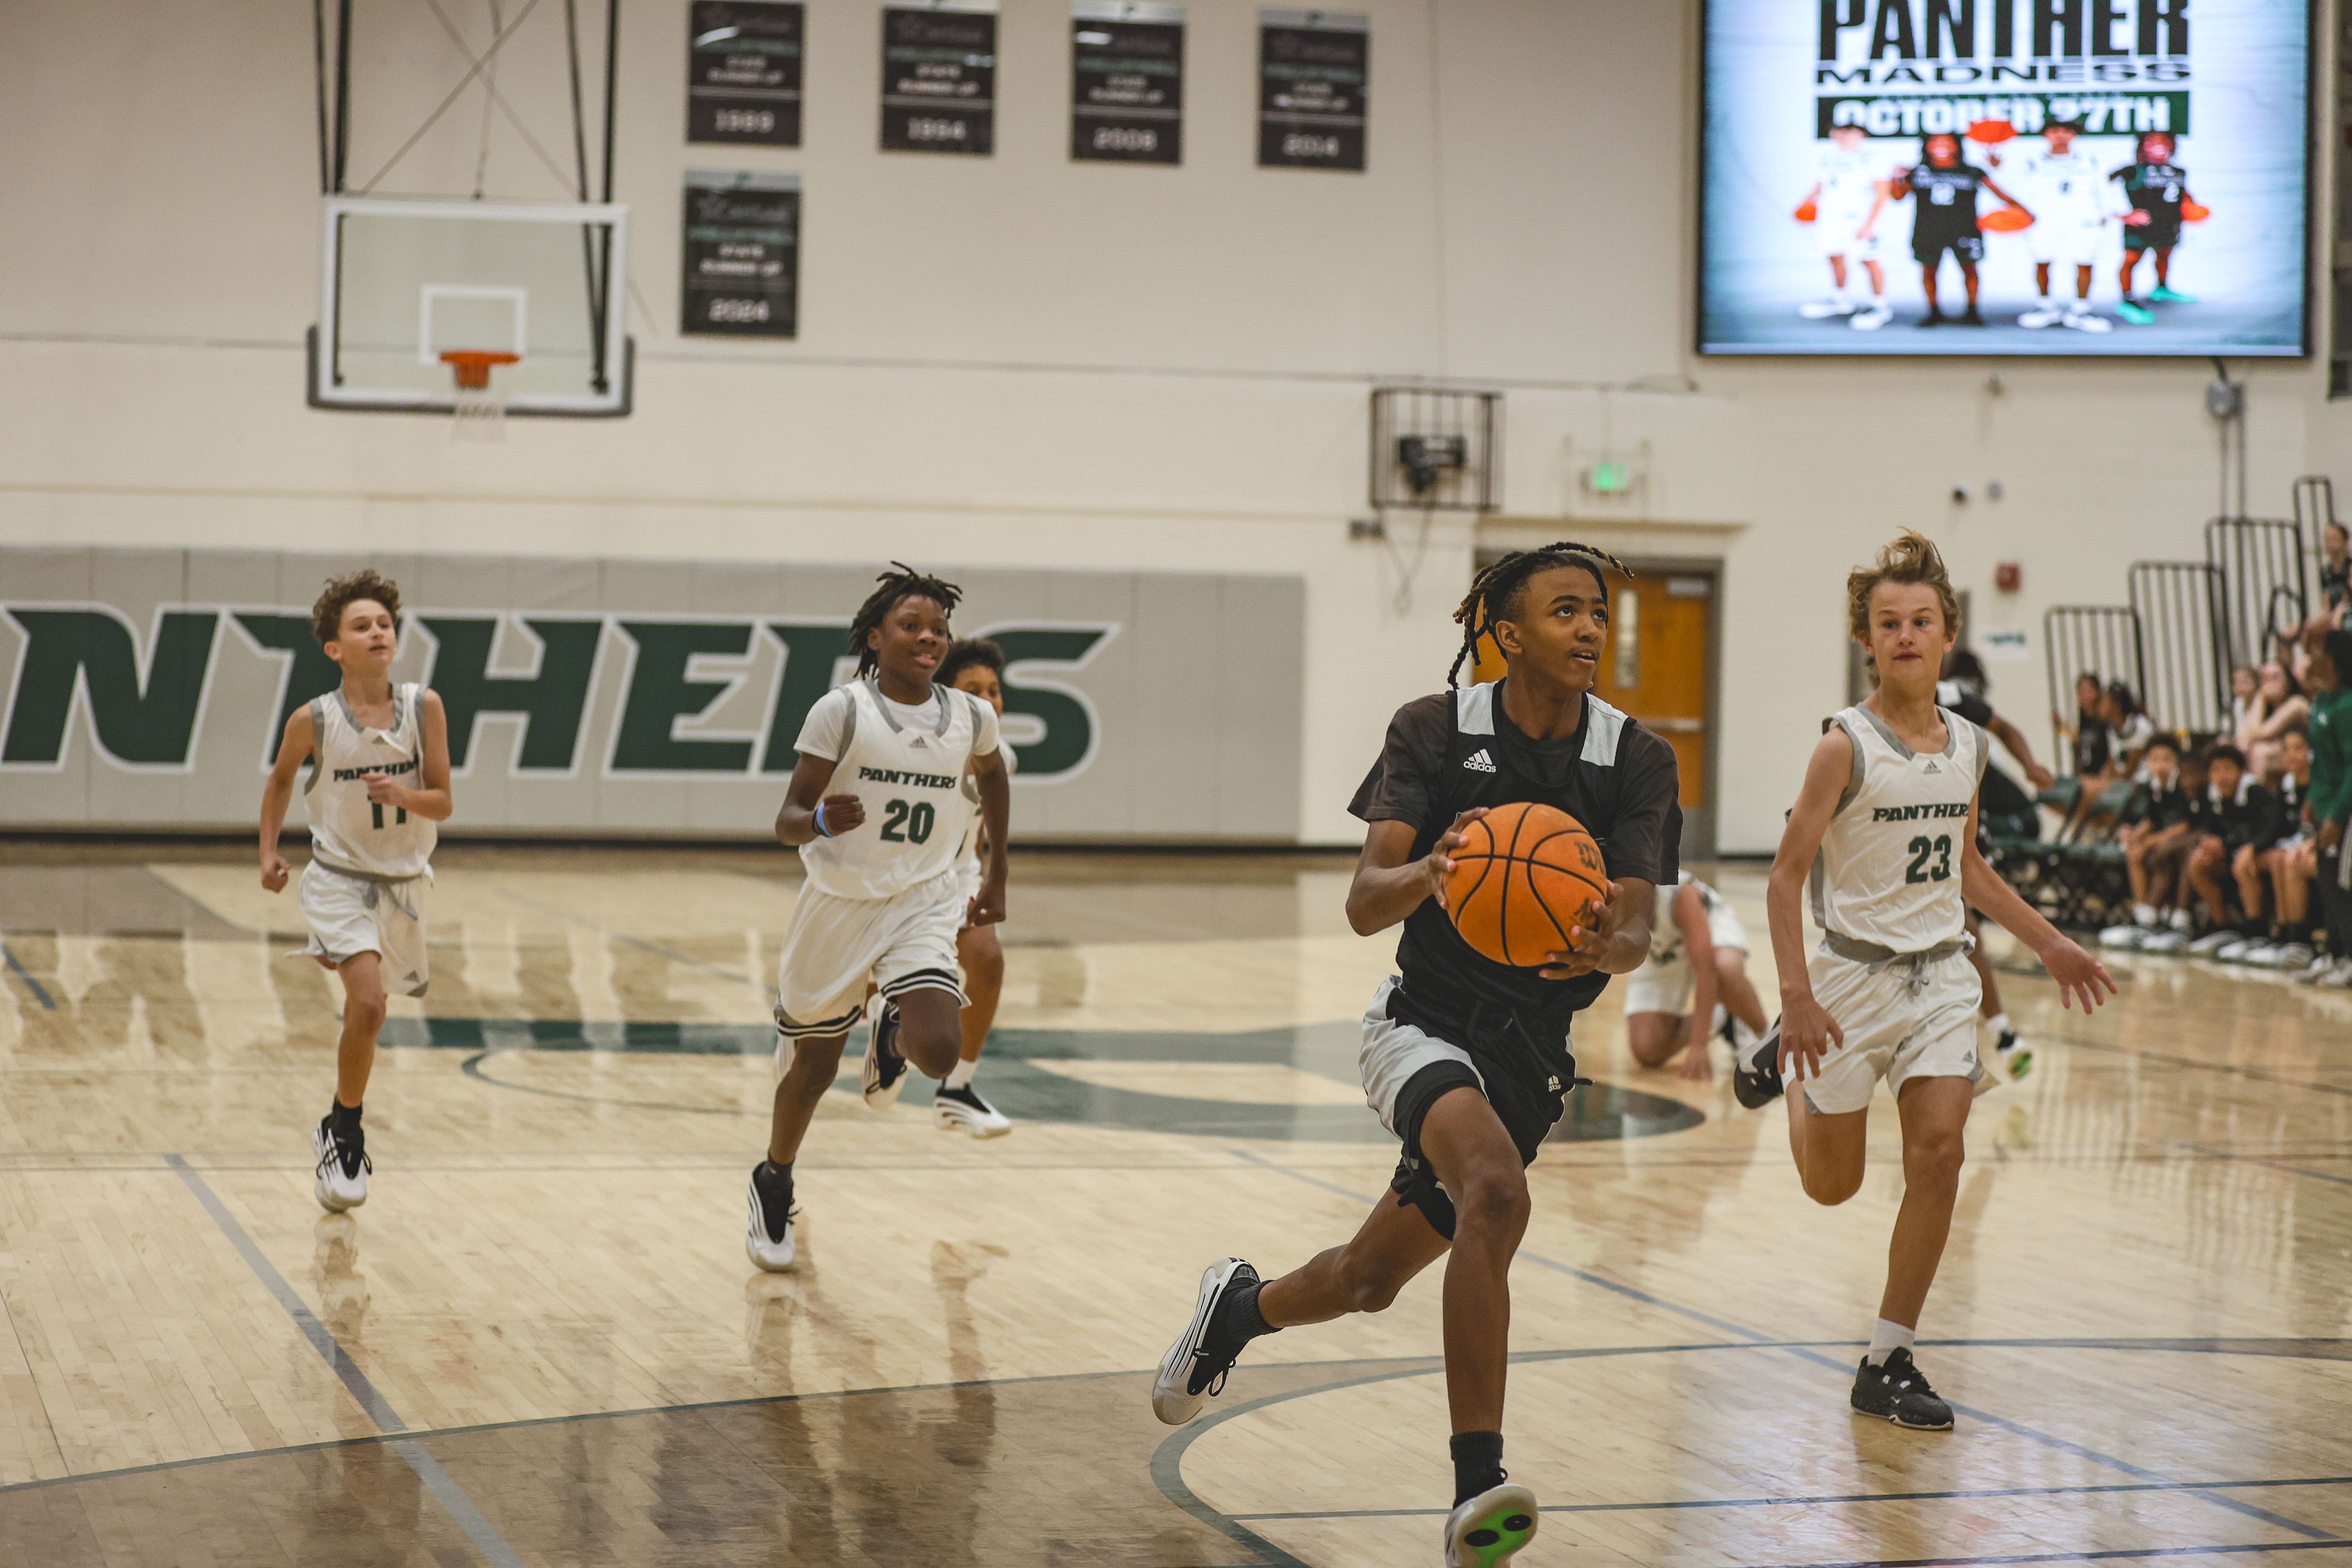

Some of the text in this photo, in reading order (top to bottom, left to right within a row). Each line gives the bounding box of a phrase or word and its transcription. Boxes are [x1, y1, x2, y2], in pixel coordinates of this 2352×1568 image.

[1820, 0, 2188, 60] PANTHER
[1817, 64, 2190, 83] MADNESS
[859, 766, 957, 788] PANTHERS
[1463, 761, 1496, 772] adidas
[880, 799, 935, 844] 20
[1906, 834, 1951, 884] 23
